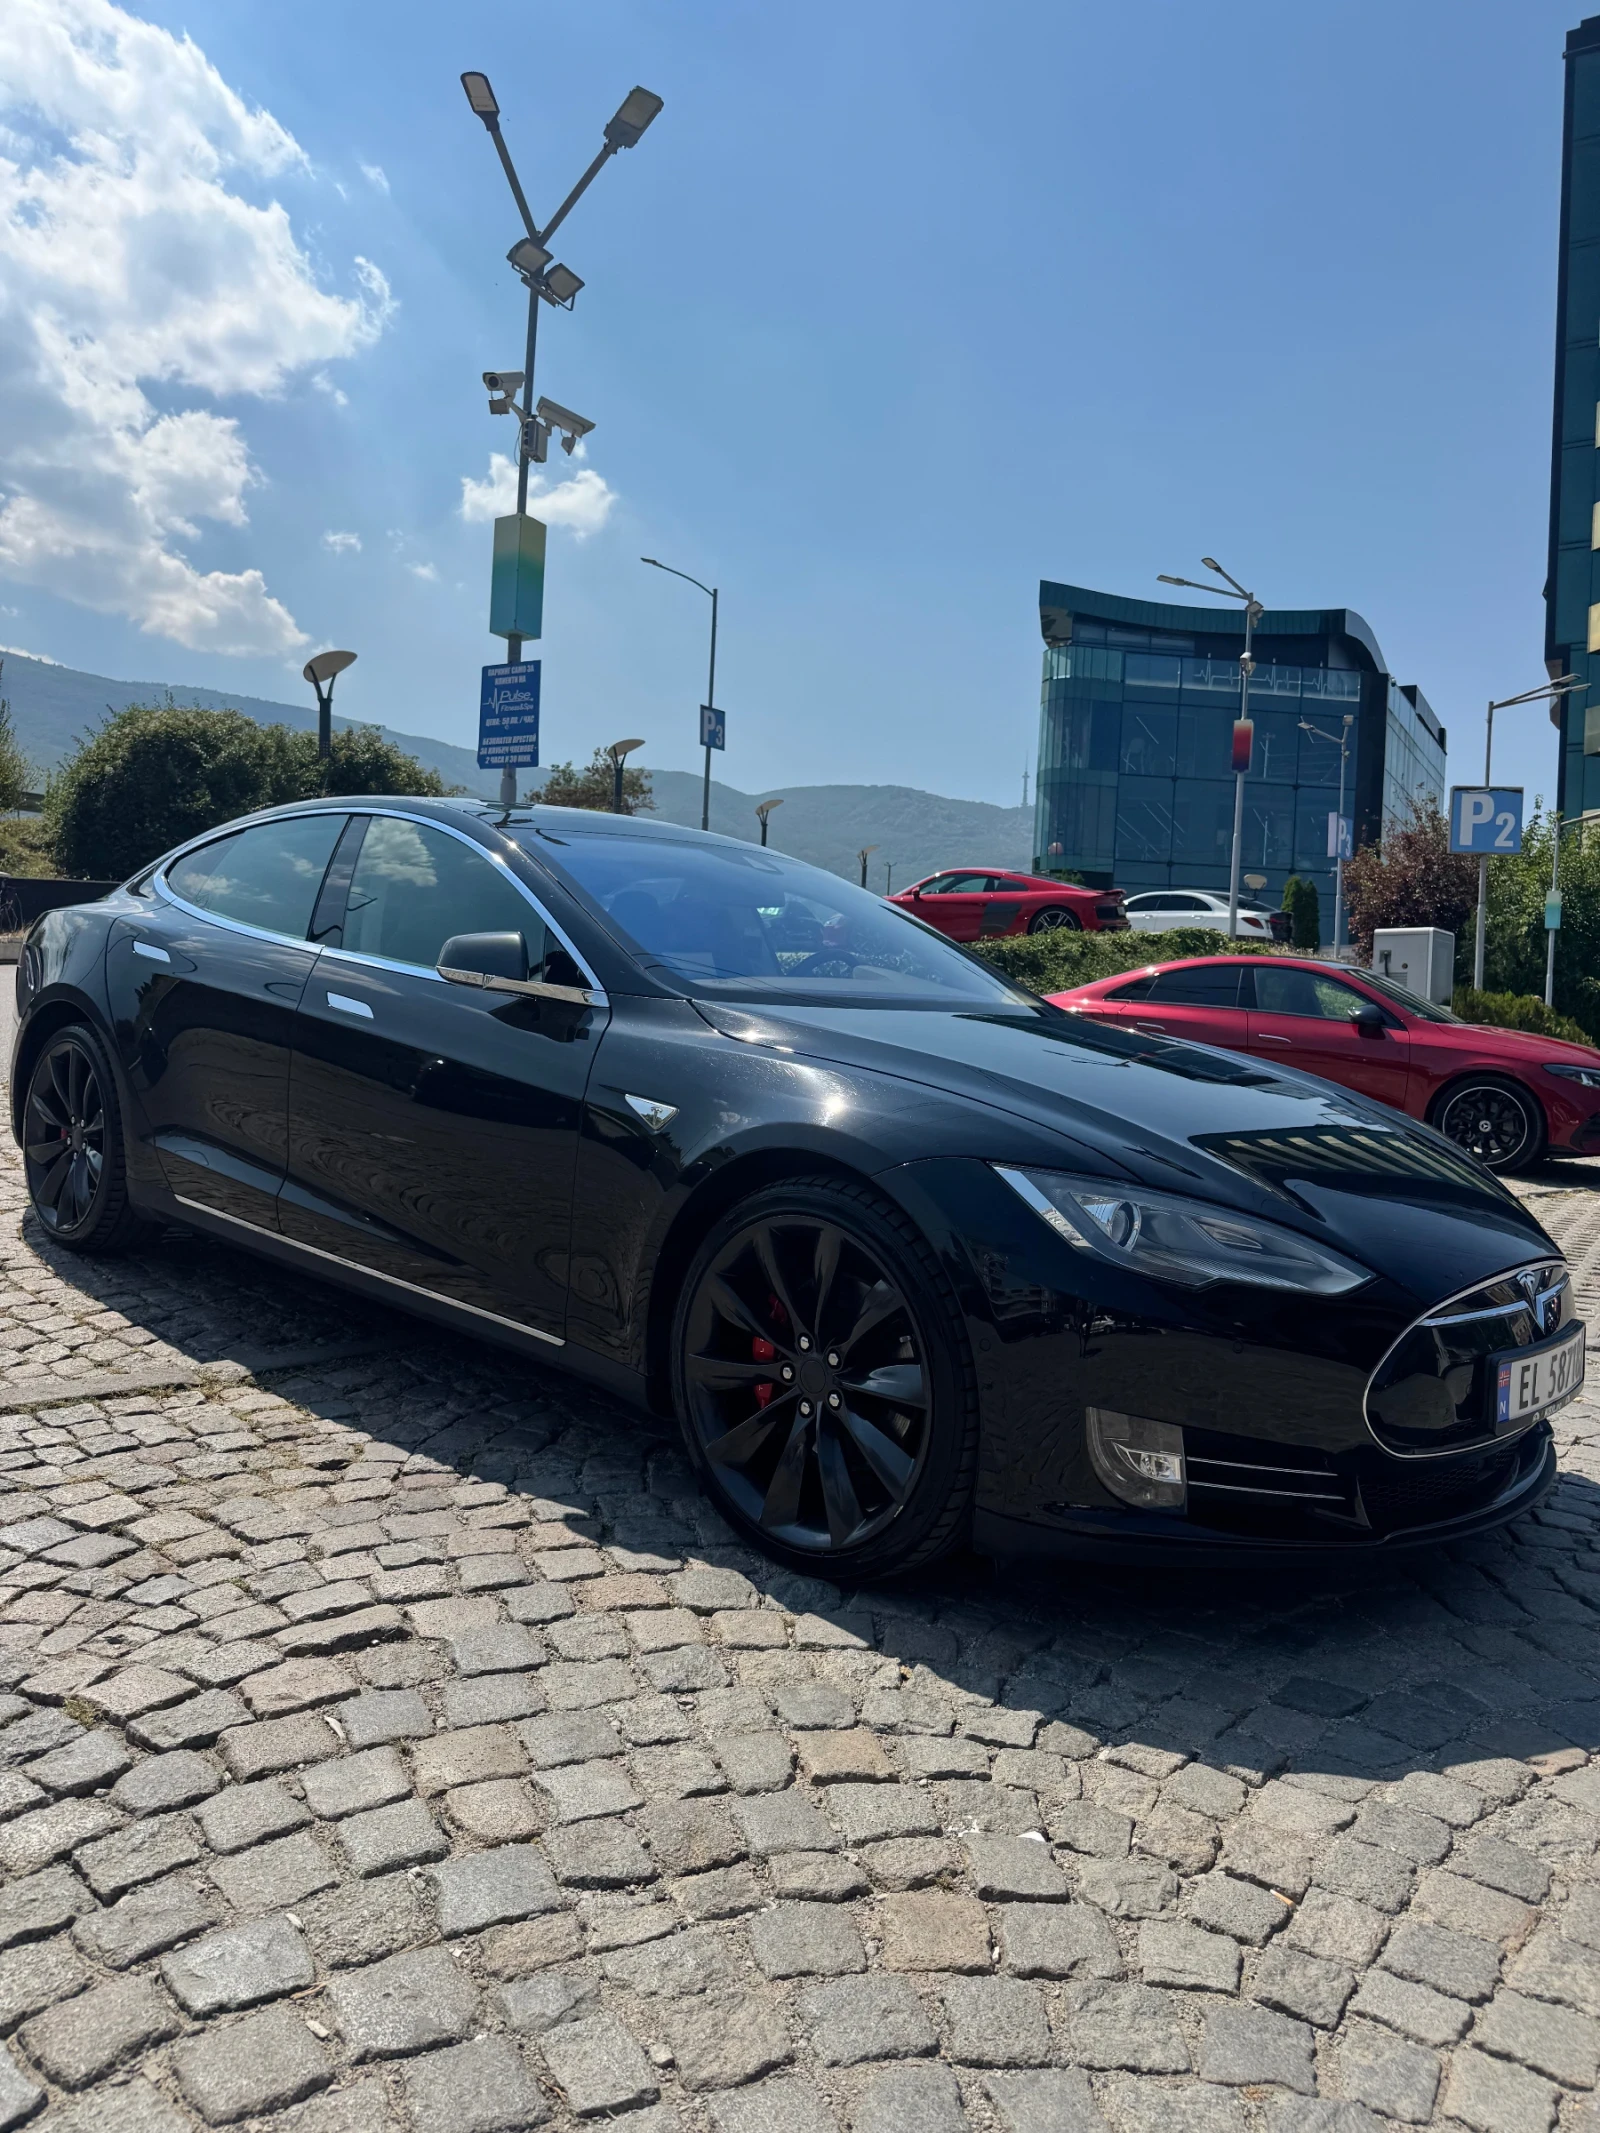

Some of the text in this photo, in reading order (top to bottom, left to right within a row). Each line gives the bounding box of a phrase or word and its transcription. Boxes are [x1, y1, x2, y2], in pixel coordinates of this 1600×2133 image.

[488, 665, 535, 676] ПАРКИНГ САМО ЗА
[495, 675, 526, 685] КЛИЕНТИ НА
[500, 690, 531, 702] Pulse
[486, 718, 501, 727] ЦЕНА:
[703, 710, 723, 747] P3
[1459, 793, 1516, 848] P2
[1338, 818, 1351, 857] P3
[1519, 1362, 1539, 1410] EL
[1500, 1400, 1506, 1415] N
